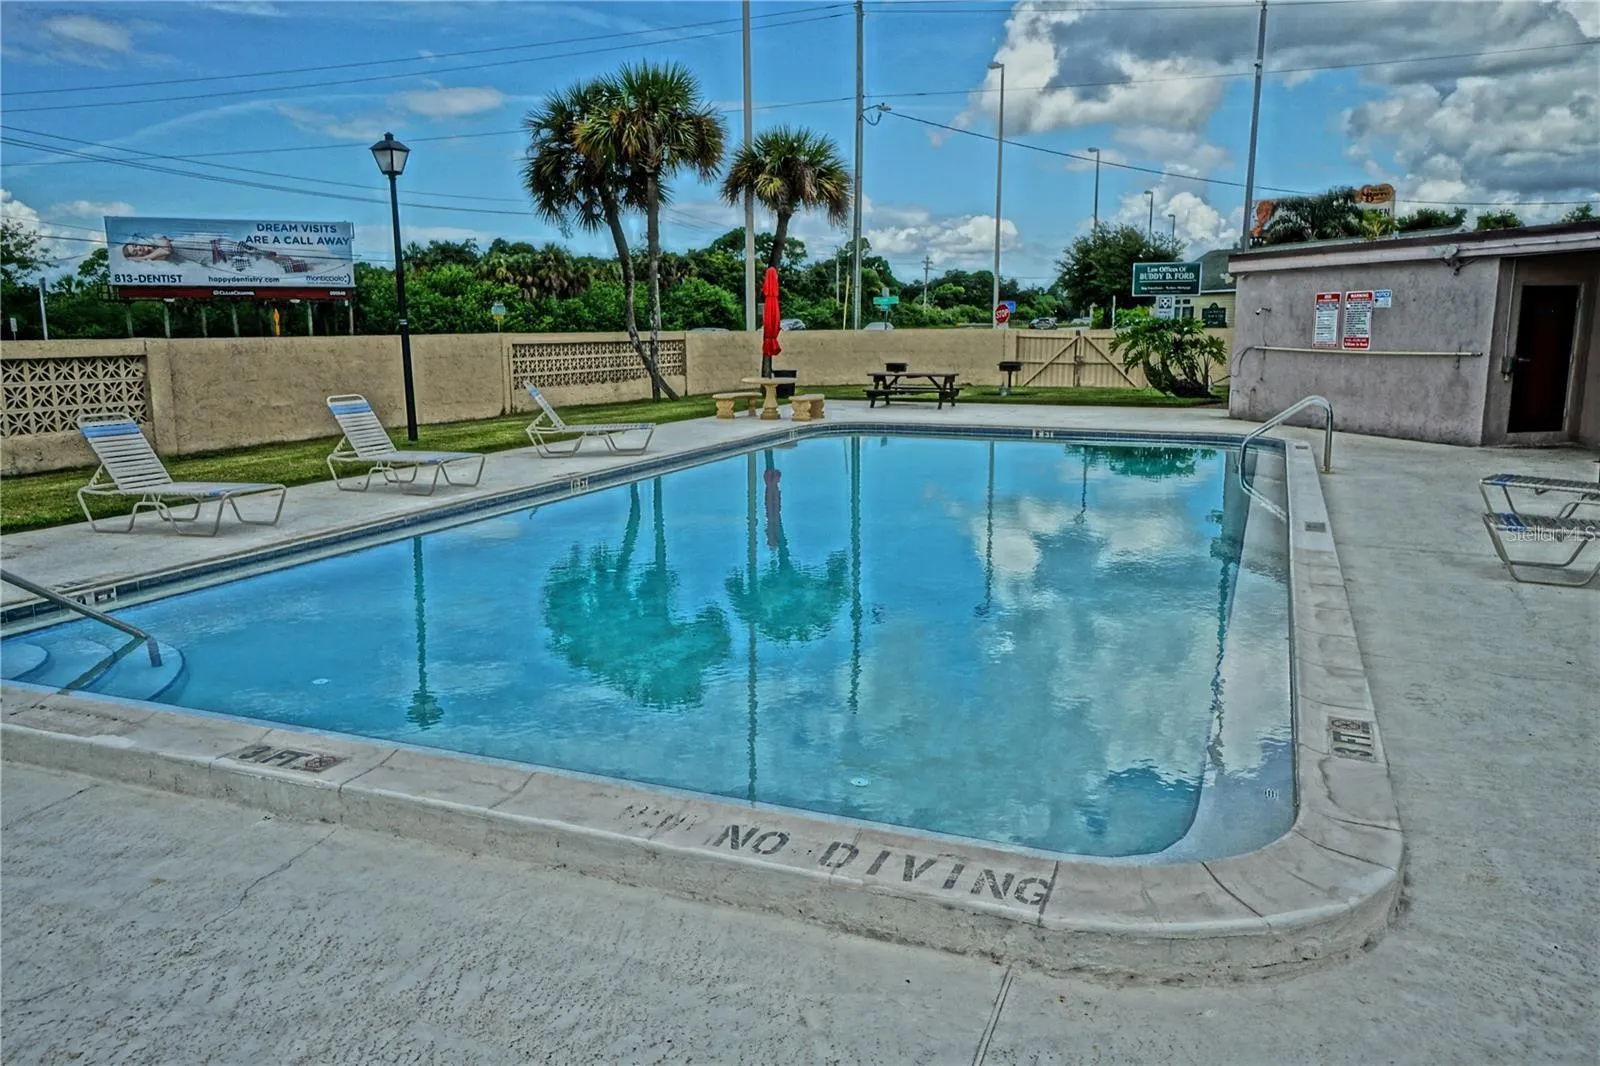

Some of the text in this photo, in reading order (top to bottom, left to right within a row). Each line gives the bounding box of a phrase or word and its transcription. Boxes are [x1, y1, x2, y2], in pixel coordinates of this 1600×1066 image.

[256, 223, 337, 234] DREAM VISITS
[245, 235, 350, 246] ARE A CALL AWAY
[114, 273, 183, 284] 813-DENTIST
[208, 275, 280, 284] happydentistry.com
[1139, 272, 1164, 280] BUDDY
[1174, 272, 1195, 280] FORD
[995, 309, 1008, 319] STOP
[712, 823, 1053, 906] NO DIVING
